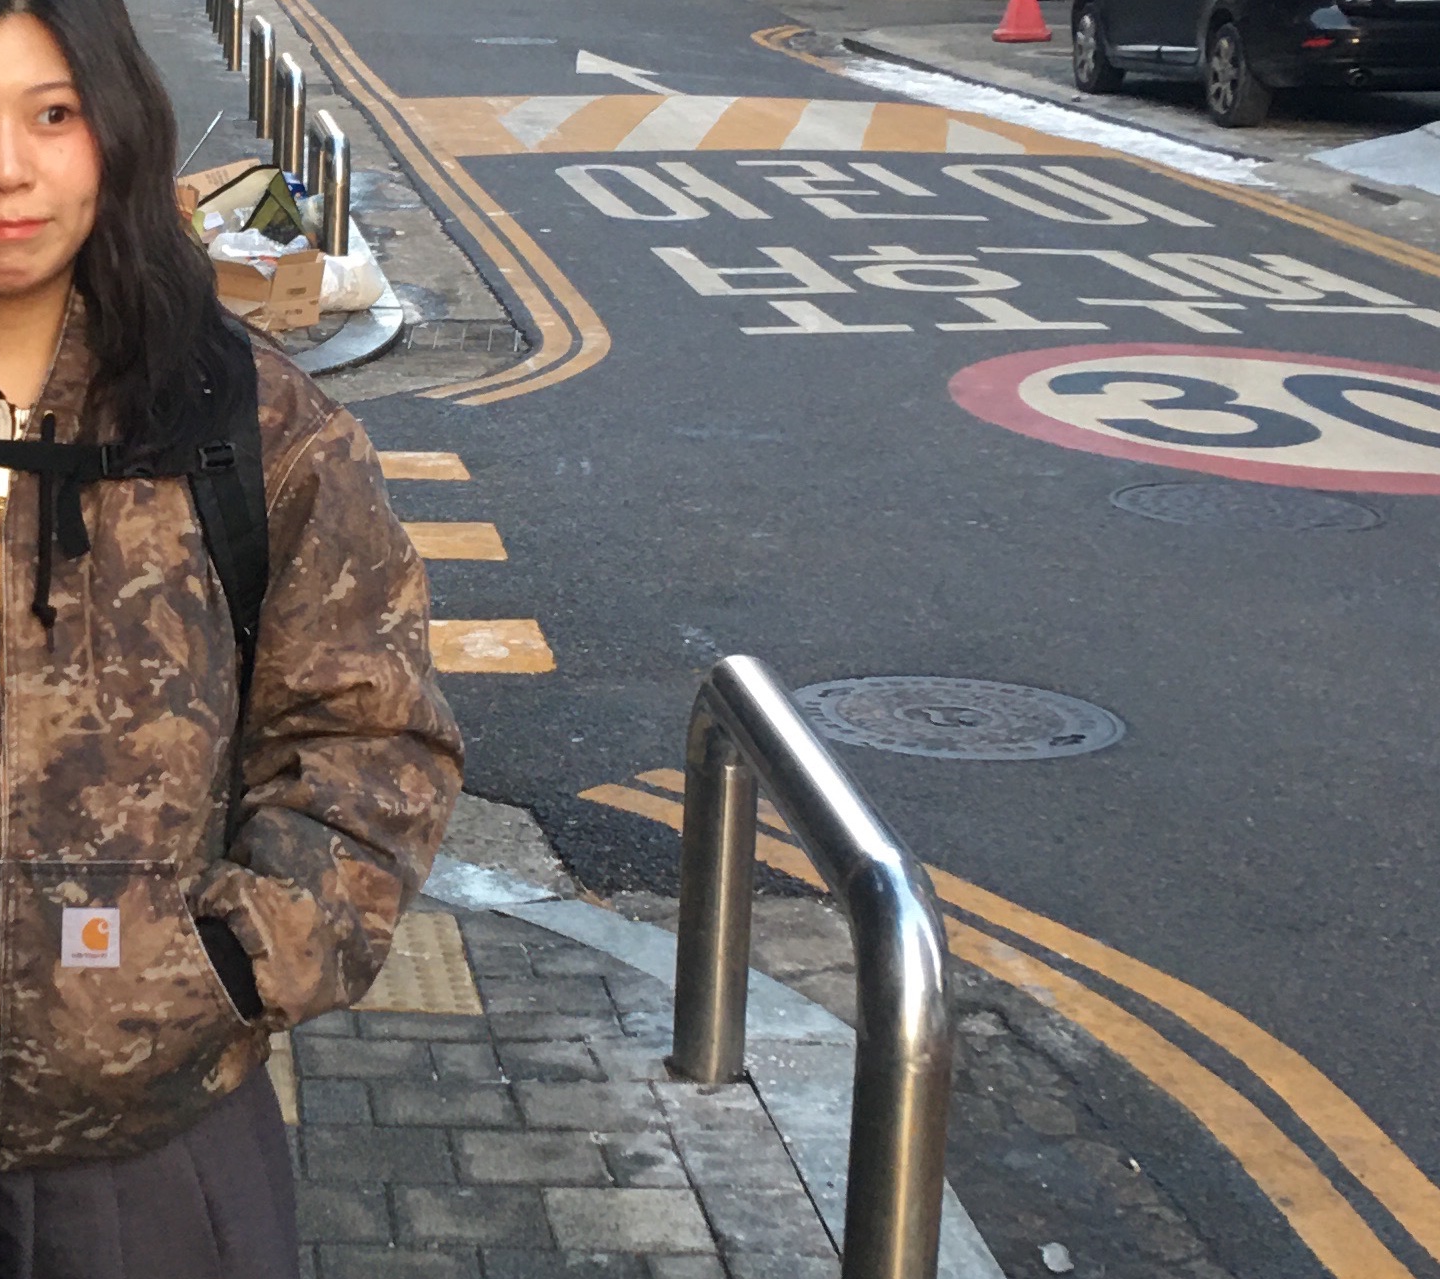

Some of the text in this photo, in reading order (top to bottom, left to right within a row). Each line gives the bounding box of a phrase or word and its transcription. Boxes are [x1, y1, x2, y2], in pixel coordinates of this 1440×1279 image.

[555, 158, 1217, 228] 어린이
[649, 244, 1440, 335] 보호구역
[1048, 370, 1440, 450] 30
